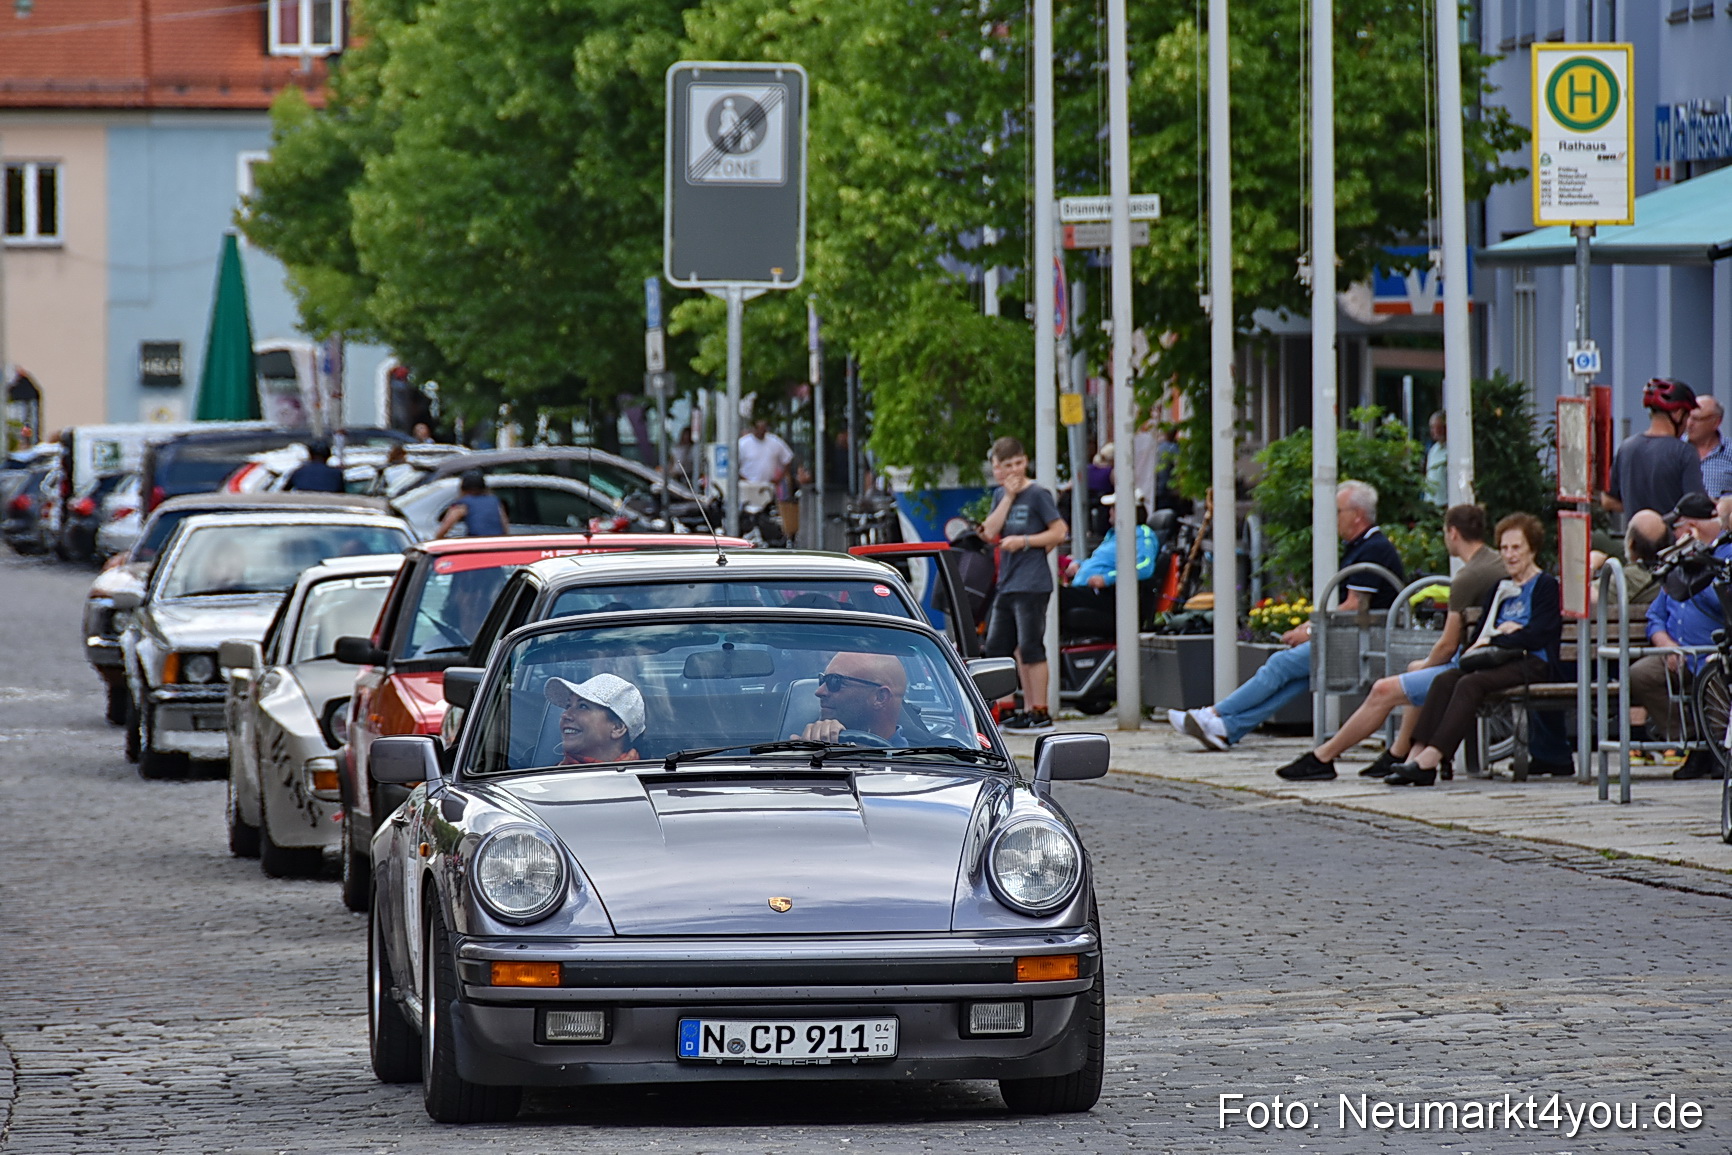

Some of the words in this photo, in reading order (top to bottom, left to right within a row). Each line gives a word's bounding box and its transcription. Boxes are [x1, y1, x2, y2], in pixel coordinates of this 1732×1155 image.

[1569, 74, 1597, 114] H
[1558, 141, 1606, 151] Rathaus
[711, 160, 760, 177] ZONE
[750, 1025, 795, 1053] CP
[806, 1024, 869, 1053] 911
[875, 1023, 889, 1032] 04
[685, 1042, 693, 1050] D
[875, 1043, 888, 1052] 10
